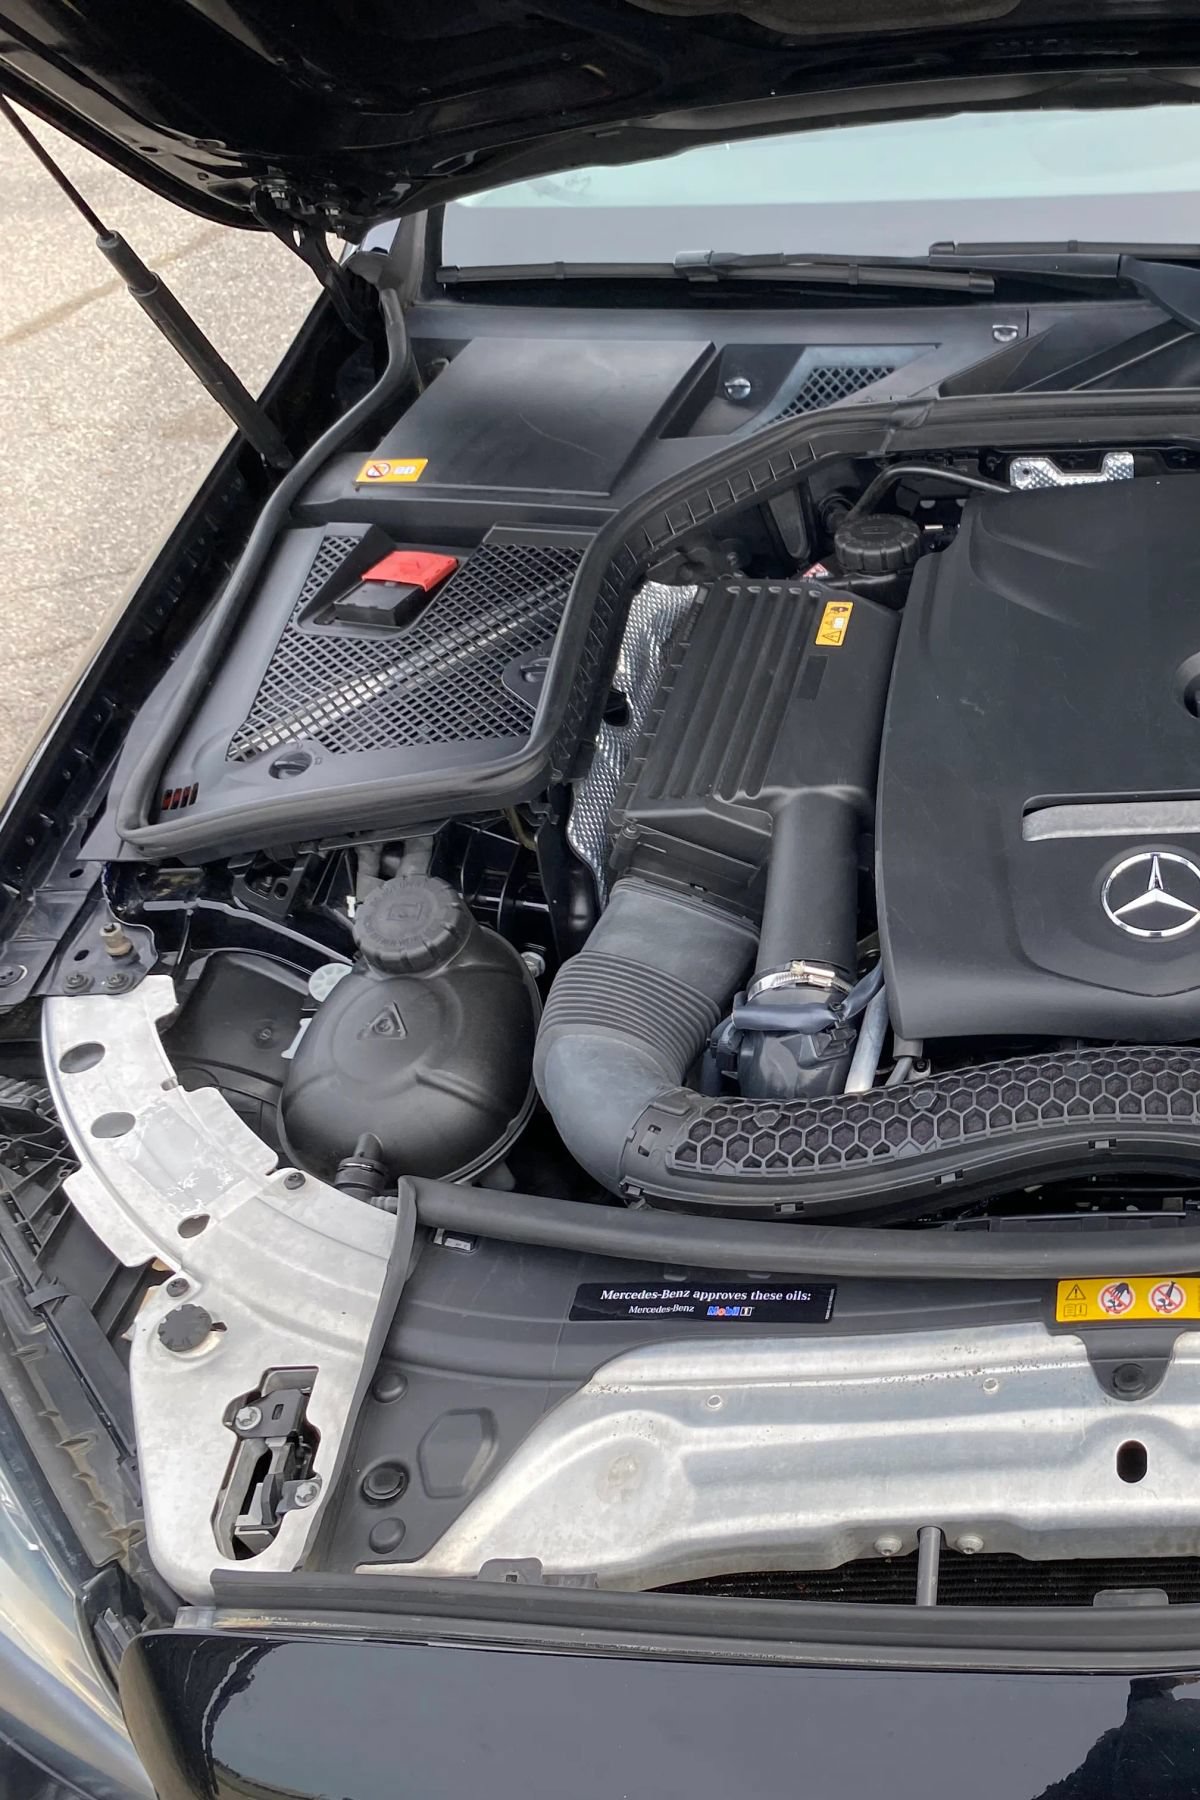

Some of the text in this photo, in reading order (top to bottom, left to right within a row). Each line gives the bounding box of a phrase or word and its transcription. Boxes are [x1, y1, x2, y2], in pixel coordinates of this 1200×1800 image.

[600, 1289, 812, 1302] Mercedes-Benz approves these oils:
[628, 1303, 695, 1314] Mercedes-Benz
[707, 1306, 740, 1316] Mobil
